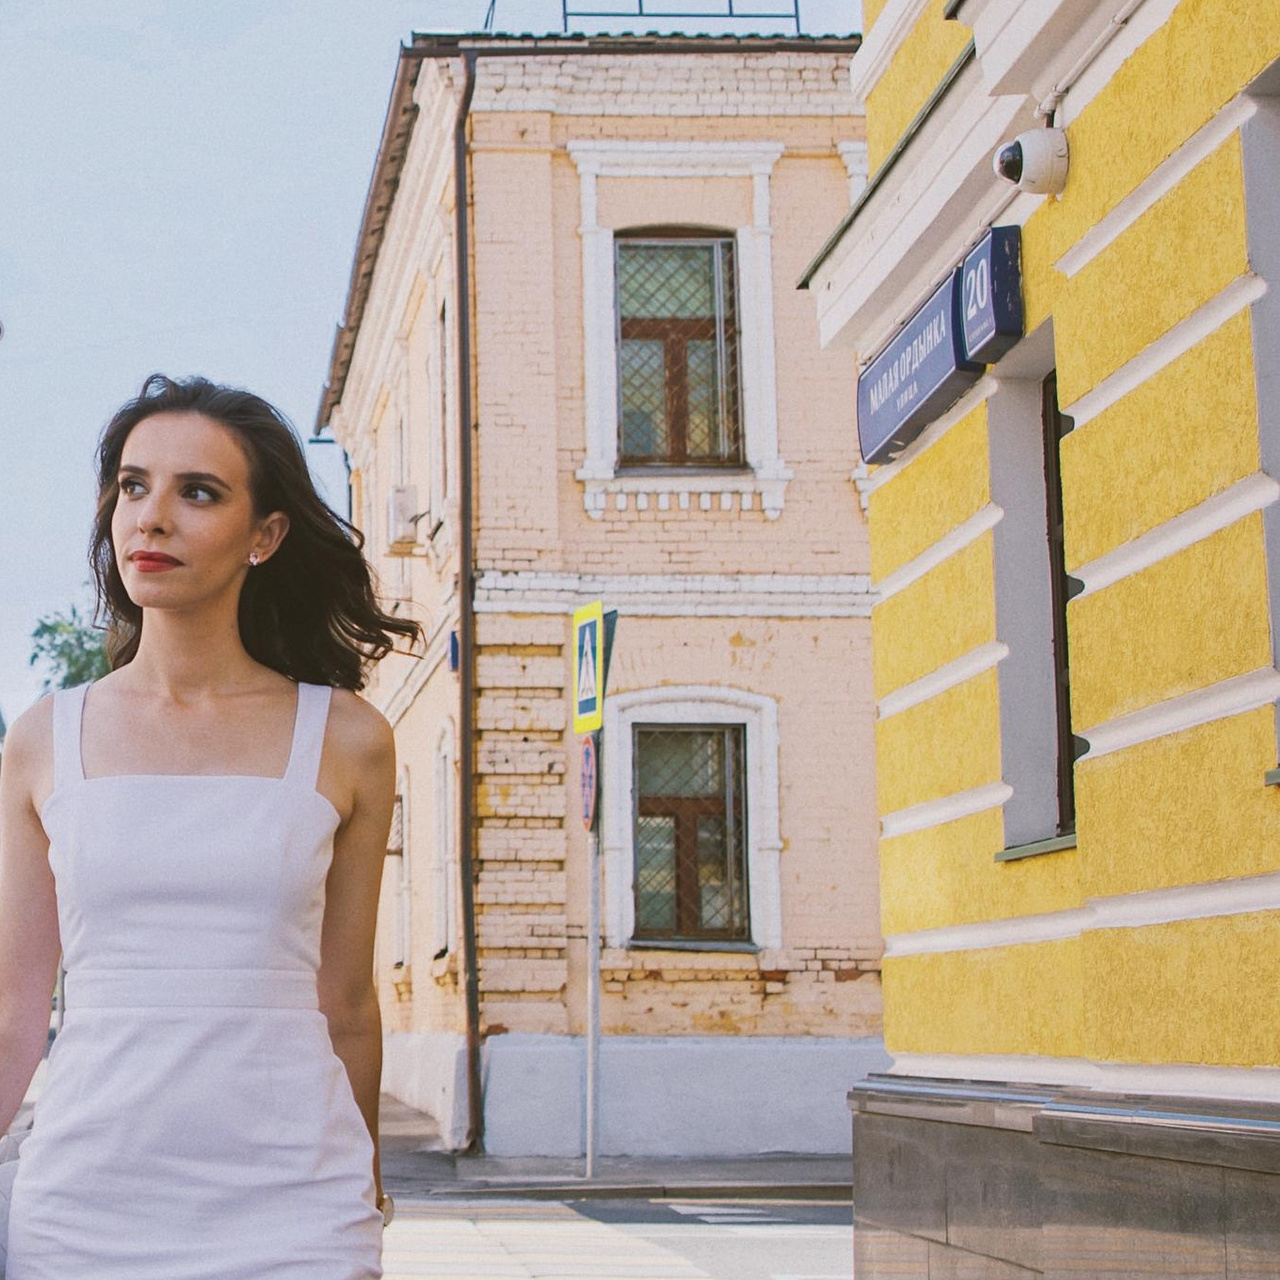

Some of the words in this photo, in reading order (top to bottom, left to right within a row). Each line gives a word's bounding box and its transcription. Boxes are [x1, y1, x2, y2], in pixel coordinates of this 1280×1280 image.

[966, 258, 988, 320] 20
[870, 360, 899, 415] МАЛАЯ
[900, 309, 946, 382] ОРДЫНКА
